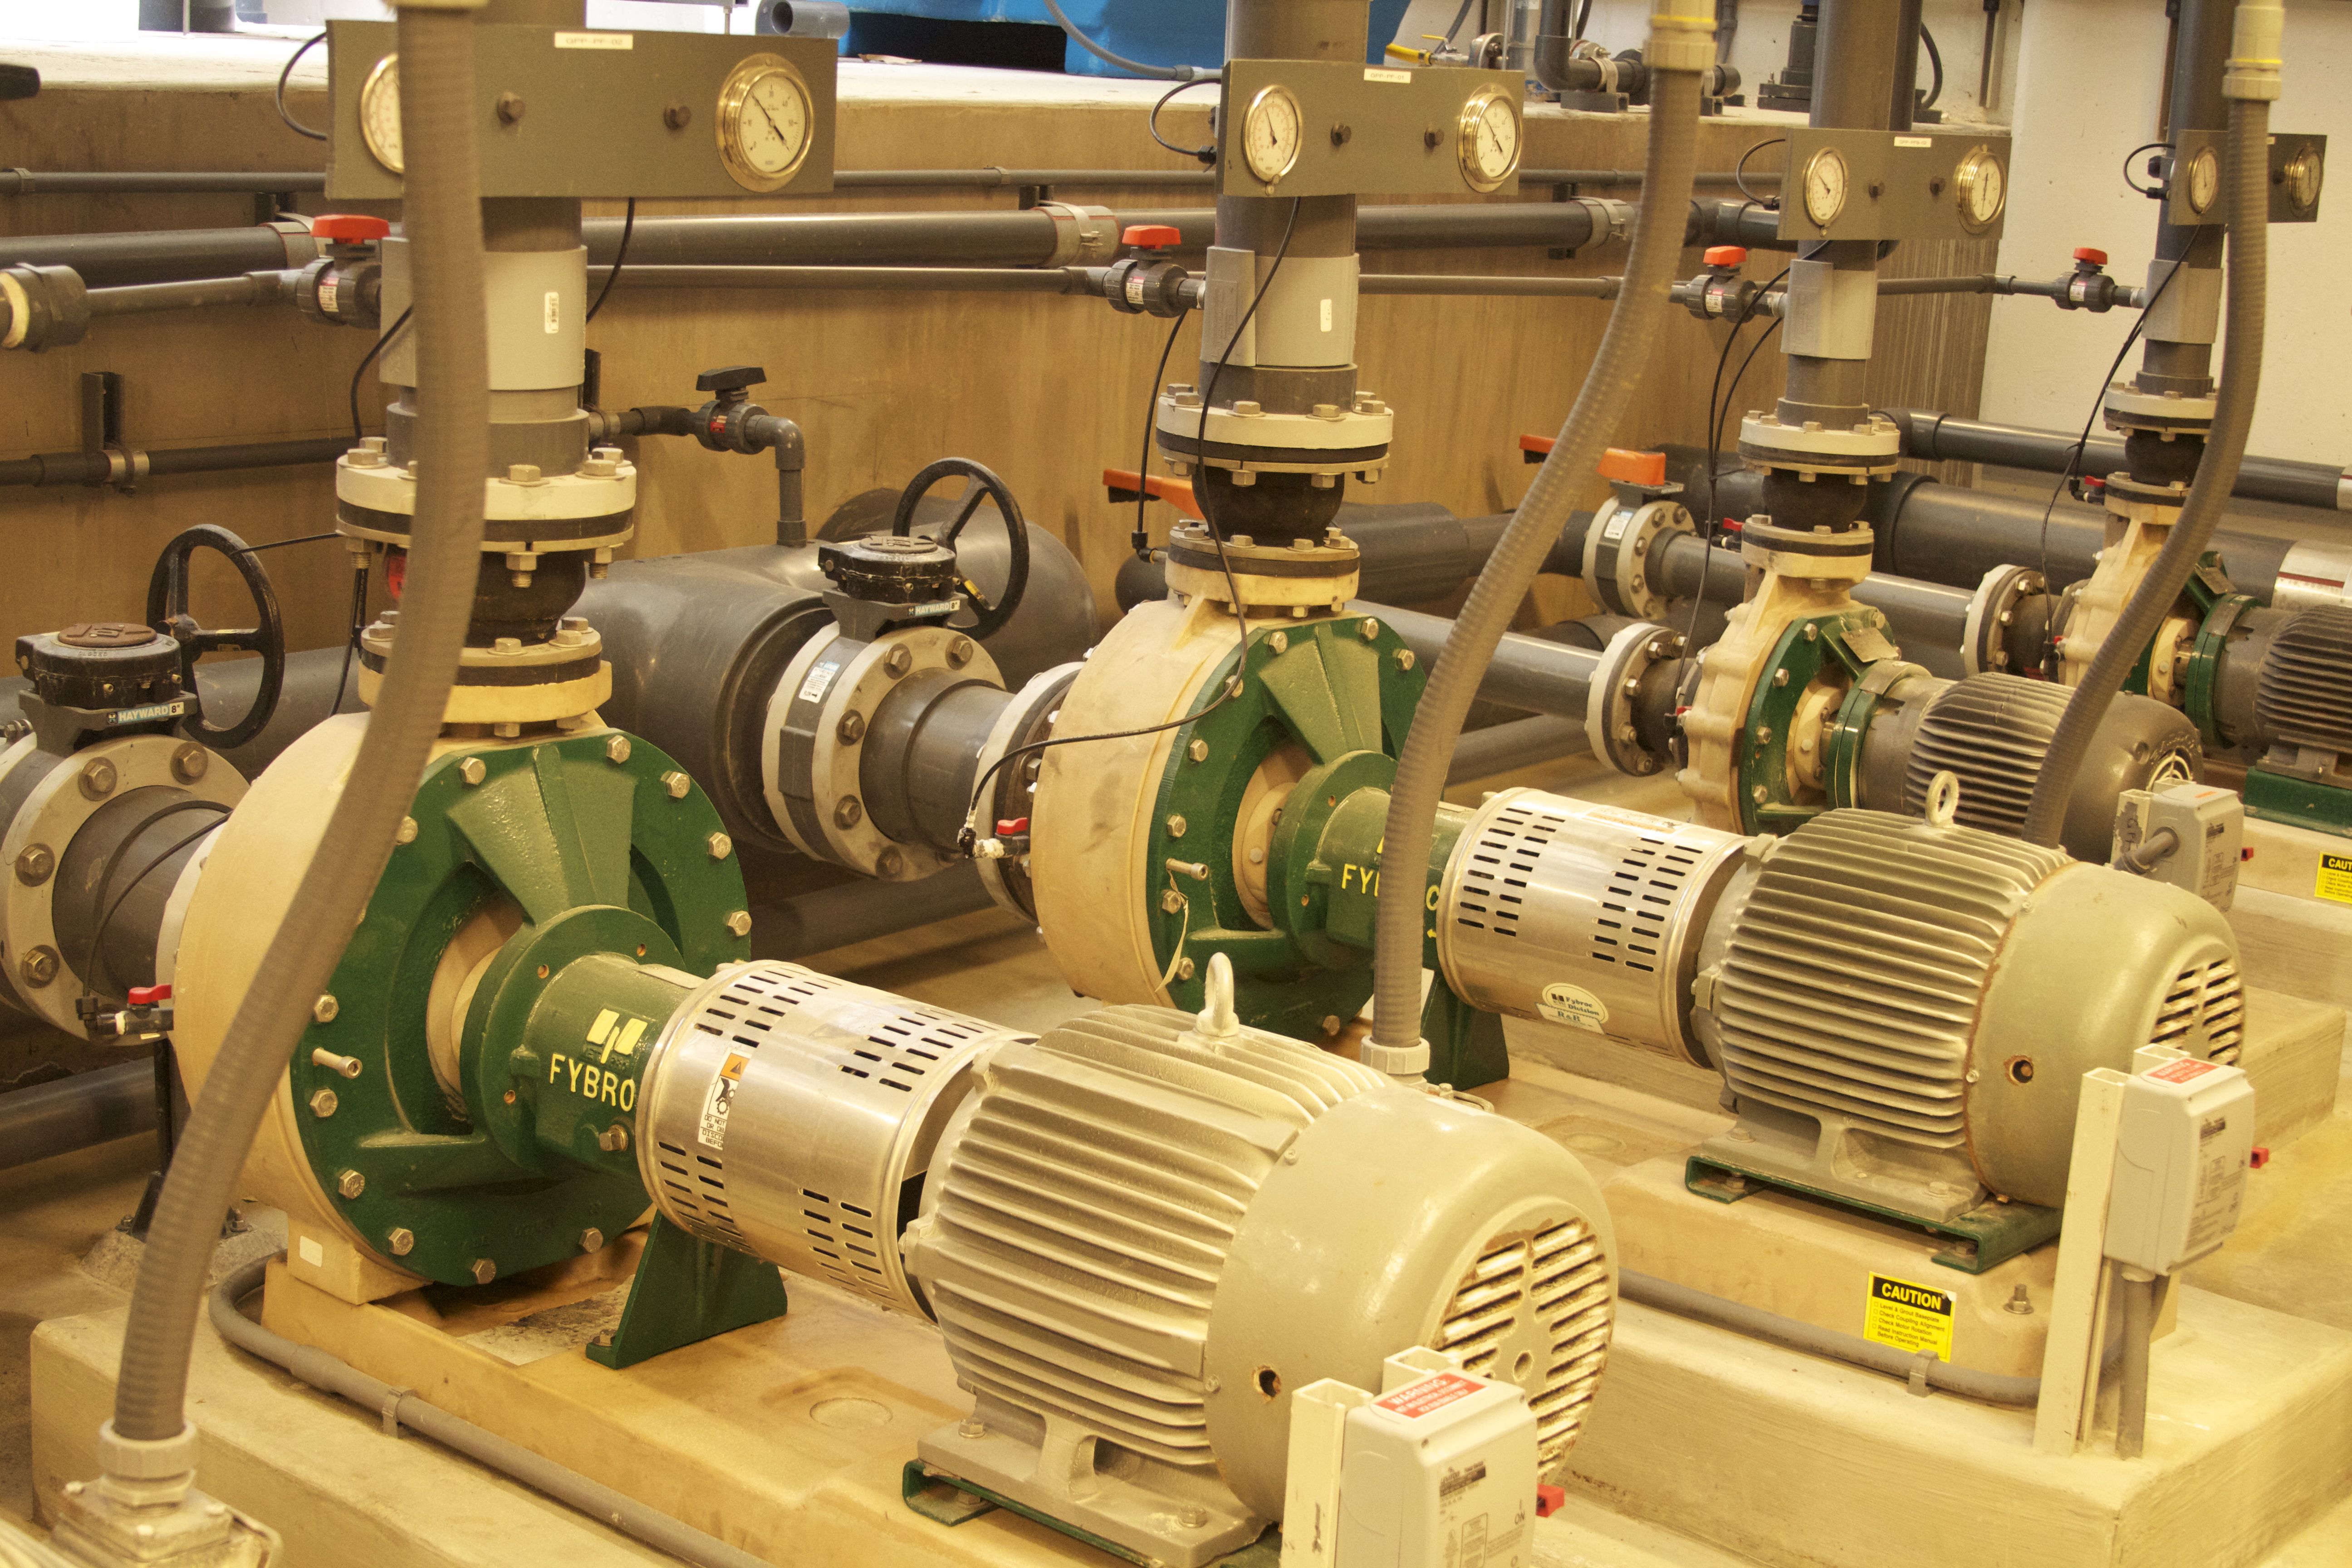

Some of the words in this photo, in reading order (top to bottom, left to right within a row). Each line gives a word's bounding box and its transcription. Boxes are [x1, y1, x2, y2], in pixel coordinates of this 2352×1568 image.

[915, 602, 949, 615] HAYWARD
[118, 706, 168, 722] HAYWARD
[171, 704, 181, 713] 8"
[1568, 1003, 1599, 1016] Division
[549, 1053, 636, 1112] FYBRO
[715, 1118, 726, 1126] NOT
[702, 1128, 725, 1142] DISCO
[706, 1137, 723, 1147] BEFO
[1882, 1282, 1942, 1311] CAUTION
[1879, 1310, 1894, 1318] Check
[1896, 1315, 1918, 1326] Coupling
[1920, 1321, 1945, 1332] Alignment
[1899, 1308, 1914, 1316] Grout
[1915, 1312, 1940, 1323] Baseplate
[1878, 1318, 1894, 1326] Check
[1896, 1322, 1910, 1330] Motor
[1911, 1326, 1932, 1336] Rotation
[1877, 1331, 1893, 1339] Before
[1895, 1335, 1919, 1348] Operating
[1891, 1328, 1919, 1339] Instruction
[1920, 1336, 1938, 1345] Manual
[1514, 1509, 1525, 1525] ON
